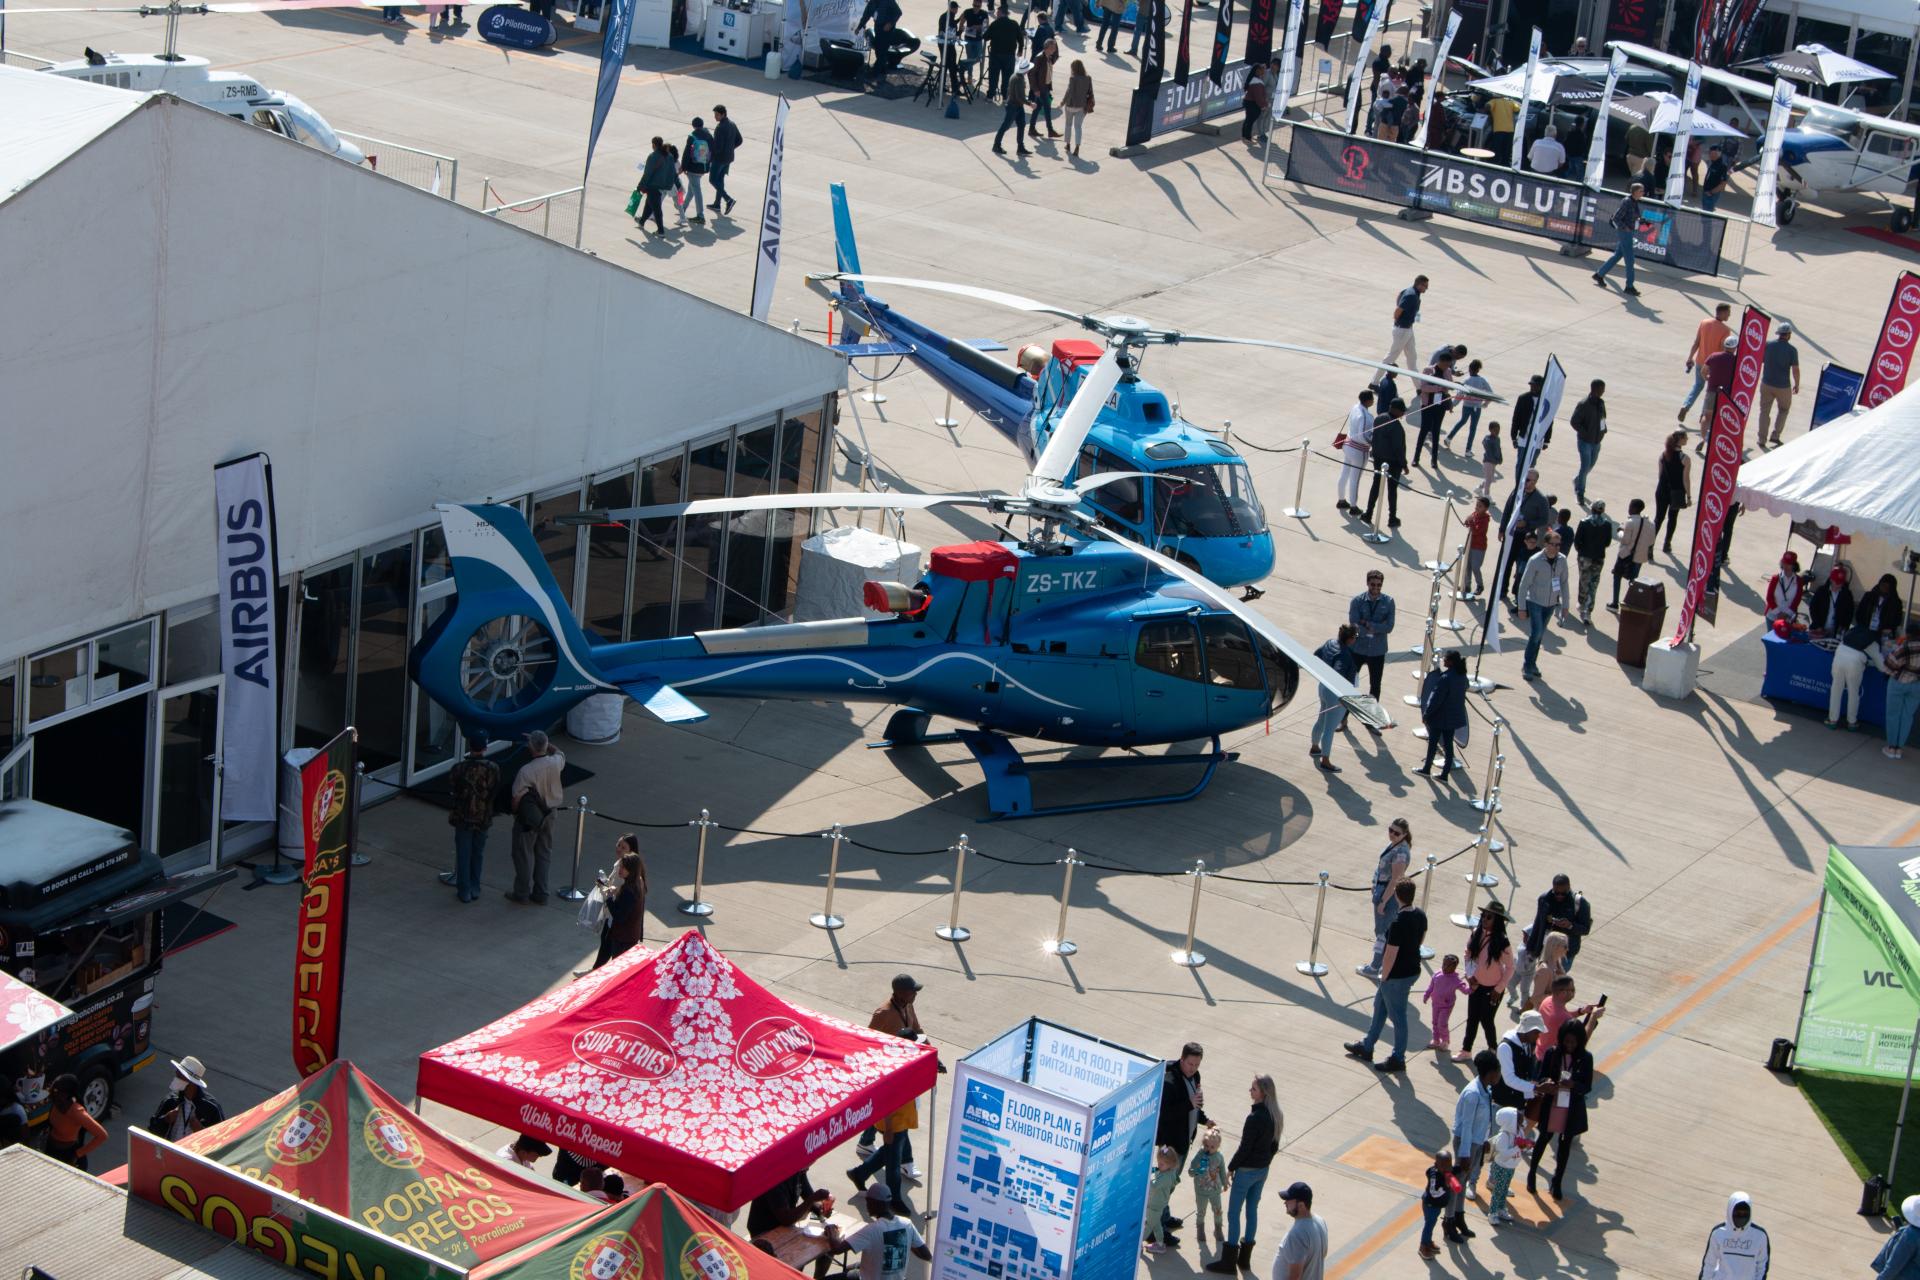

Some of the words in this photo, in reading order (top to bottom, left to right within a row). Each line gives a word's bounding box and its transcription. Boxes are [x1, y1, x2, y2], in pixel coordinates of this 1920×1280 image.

[226, 85, 258, 98] ZS-RMB
[1411, 159, 1598, 223] ABSOLUTE
[1632, 237, 1667, 256] Cessna
[1748, 325, 1763, 342] absa
[1889, 325, 1910, 340] absa
[1741, 363, 1758, 379] absa
[1879, 357, 1901, 373] absa
[1872, 391, 1889, 402] abs
[1721, 411, 1740, 429] absa
[1716, 440, 1737, 459] absa
[1713, 468, 1730, 488] absa
[1027, 570, 1097, 593] ZS-TKZ
[226, 498, 270, 689] AIRBUS
[51, 879, 68, 893] BOOK
[1867, 915, 1885, 936] NOT
[601, 1057, 622, 1070] ORIGINAL
[1116, 1082, 1156, 1117] WORKSHOP
[966, 1105, 1000, 1124] AERO
[1007, 1098, 1041, 1123] FLOOR
[1043, 1109, 1072, 1132] PLAN
[1074, 1122, 1082, 1137] &
[1112, 1098, 1158, 1140] PROGRAMME
[520, 1104, 553, 1134] Walk,
[555, 1115, 577, 1143] Eat,
[578, 1124, 622, 1158] Repeat
[805, 1130, 828, 1155] Walk,
[828, 1116, 844, 1140] Eat,
[844, 1097, 874, 1131] Repeat
[1005, 1117, 1053, 1145] EXHIBITOR
[1054, 1135, 1089, 1155] LISTING
[1092, 1131, 1112, 1151] AERO
[362, 1167, 493, 1235] PORRA'S
